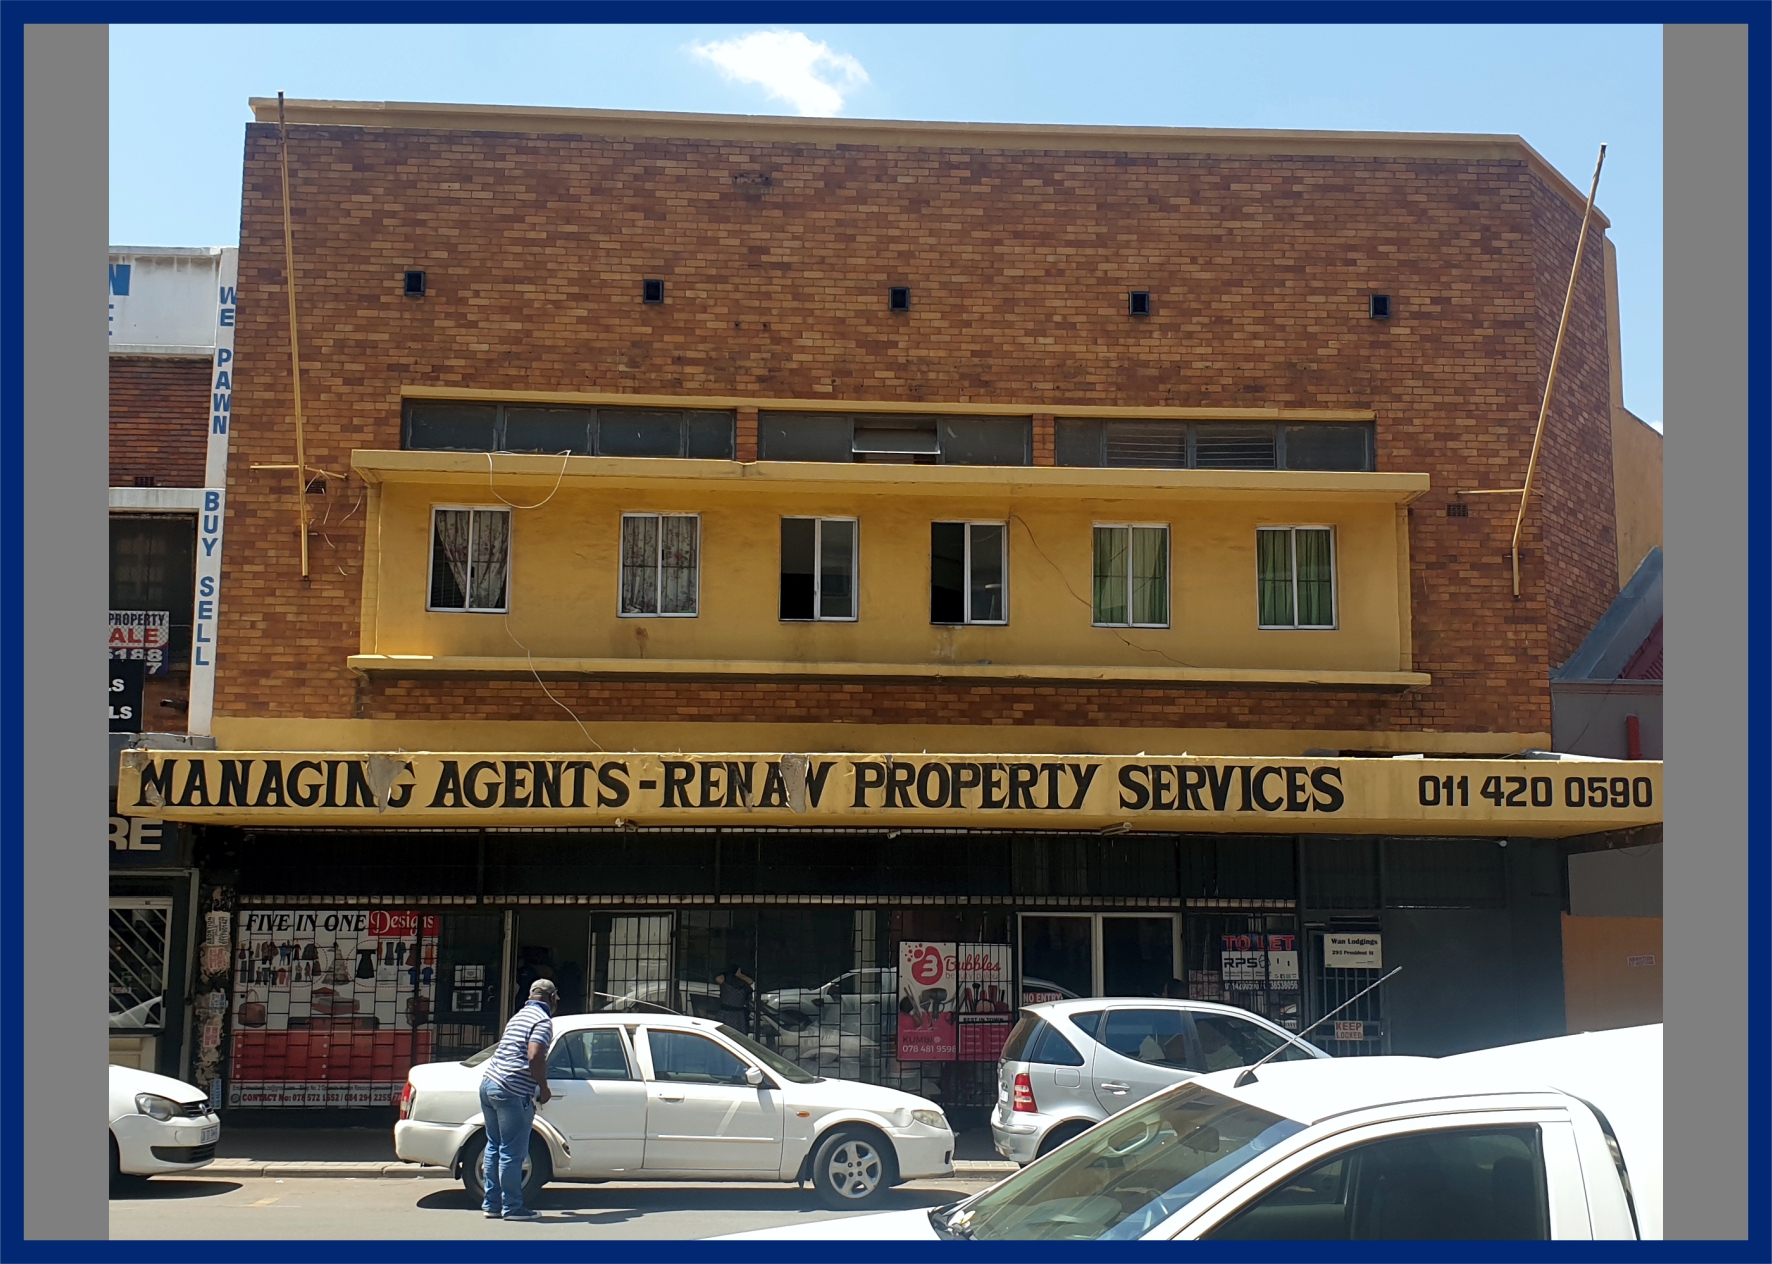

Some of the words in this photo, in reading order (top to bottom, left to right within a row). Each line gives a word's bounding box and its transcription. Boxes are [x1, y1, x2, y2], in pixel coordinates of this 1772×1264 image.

[219, 286, 237, 327] WE
[212, 348, 232, 435] PAWN
[202, 491, 220, 557] BUY
[109, 613, 165, 626] PROPERTY
[195, 576, 215, 666] SELL
[132, 759, 417, 808] MANAGING
[426, 760, 630, 808] AGENTS
[849, 762, 1104, 811] PROPERTY
[1118, 764, 1345, 813] SERVICES
[1418, 775, 1470, 807] 011
[1480, 776, 1553, 807] 420
[1565, 777, 1653, 808] 0590
[245, 913, 290, 932] FIVE
[295, 913, 319, 932] IN
[324, 913, 367, 932] ONE
[370, 910, 434, 936] Designs
[1222, 934, 1250, 951] TO
[1256, 934, 1295, 951] LET
[1347, 938, 1378, 946] Lodgings
[943, 954, 1001, 972] Bubbles
[1223, 957, 1258, 968] RPS
[1023, 992, 1035, 1003] NO
[1335, 1022, 1362, 1031] KEEP
[902, 1035, 933, 1043] KUMBI
[1336, 1031, 1363, 1039] LOCKED
[902, 1045, 919, 1053] 078
[920, 1045, 934, 1053] 481
[936, 1045, 957, 1053] 9598
[242, 1093, 277, 1102] CONTACT
